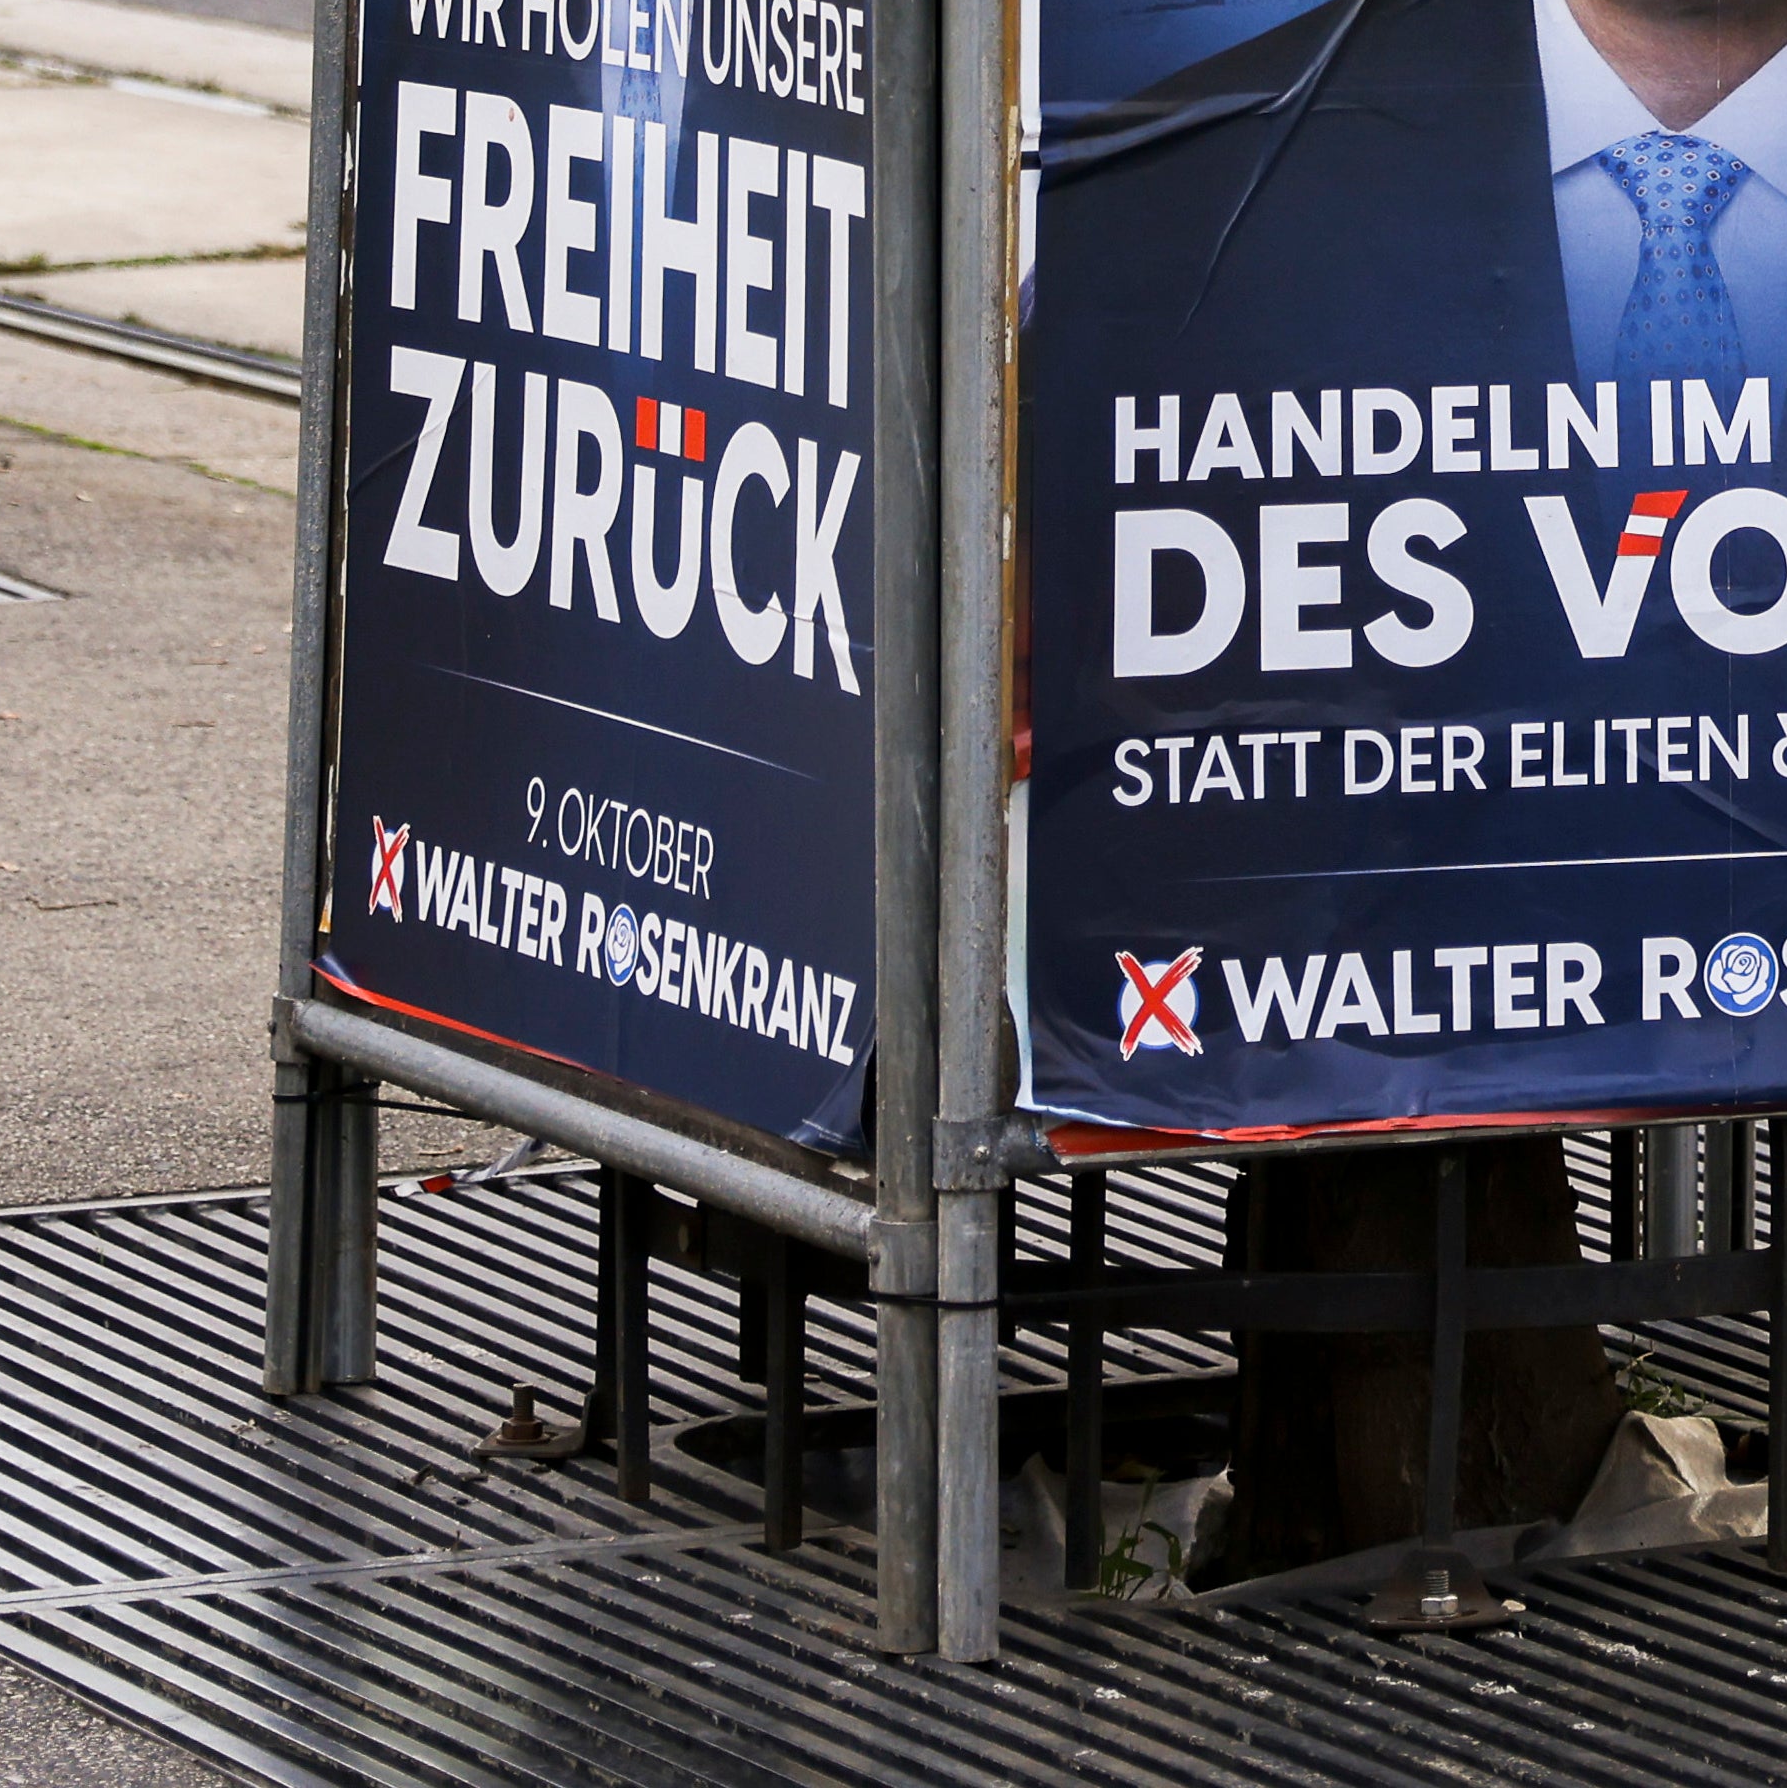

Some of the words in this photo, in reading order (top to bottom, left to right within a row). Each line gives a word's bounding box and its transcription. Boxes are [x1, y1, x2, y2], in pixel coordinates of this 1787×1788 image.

[390, 80, 867, 410] FREIHEIT
[1115, 380, 1619, 484] HANDELN
[1650, 376, 1772, 467] IM
[382, 344, 862, 697] ZURÜCK
[1113, 497, 1474, 679] DES
[526, 775, 548, 849] 9.
[558, 786, 714, 900] OKTOBER
[1111, 730, 1322, 808] STATT
[1342, 725, 1488, 796] DER
[1510, 714, 1750, 789] ELITEN
[416, 839, 568, 967] WALTER
[576, 891, 858, 1067] ROSENKRANZ
[1221, 943, 1605, 1043] WALTER
